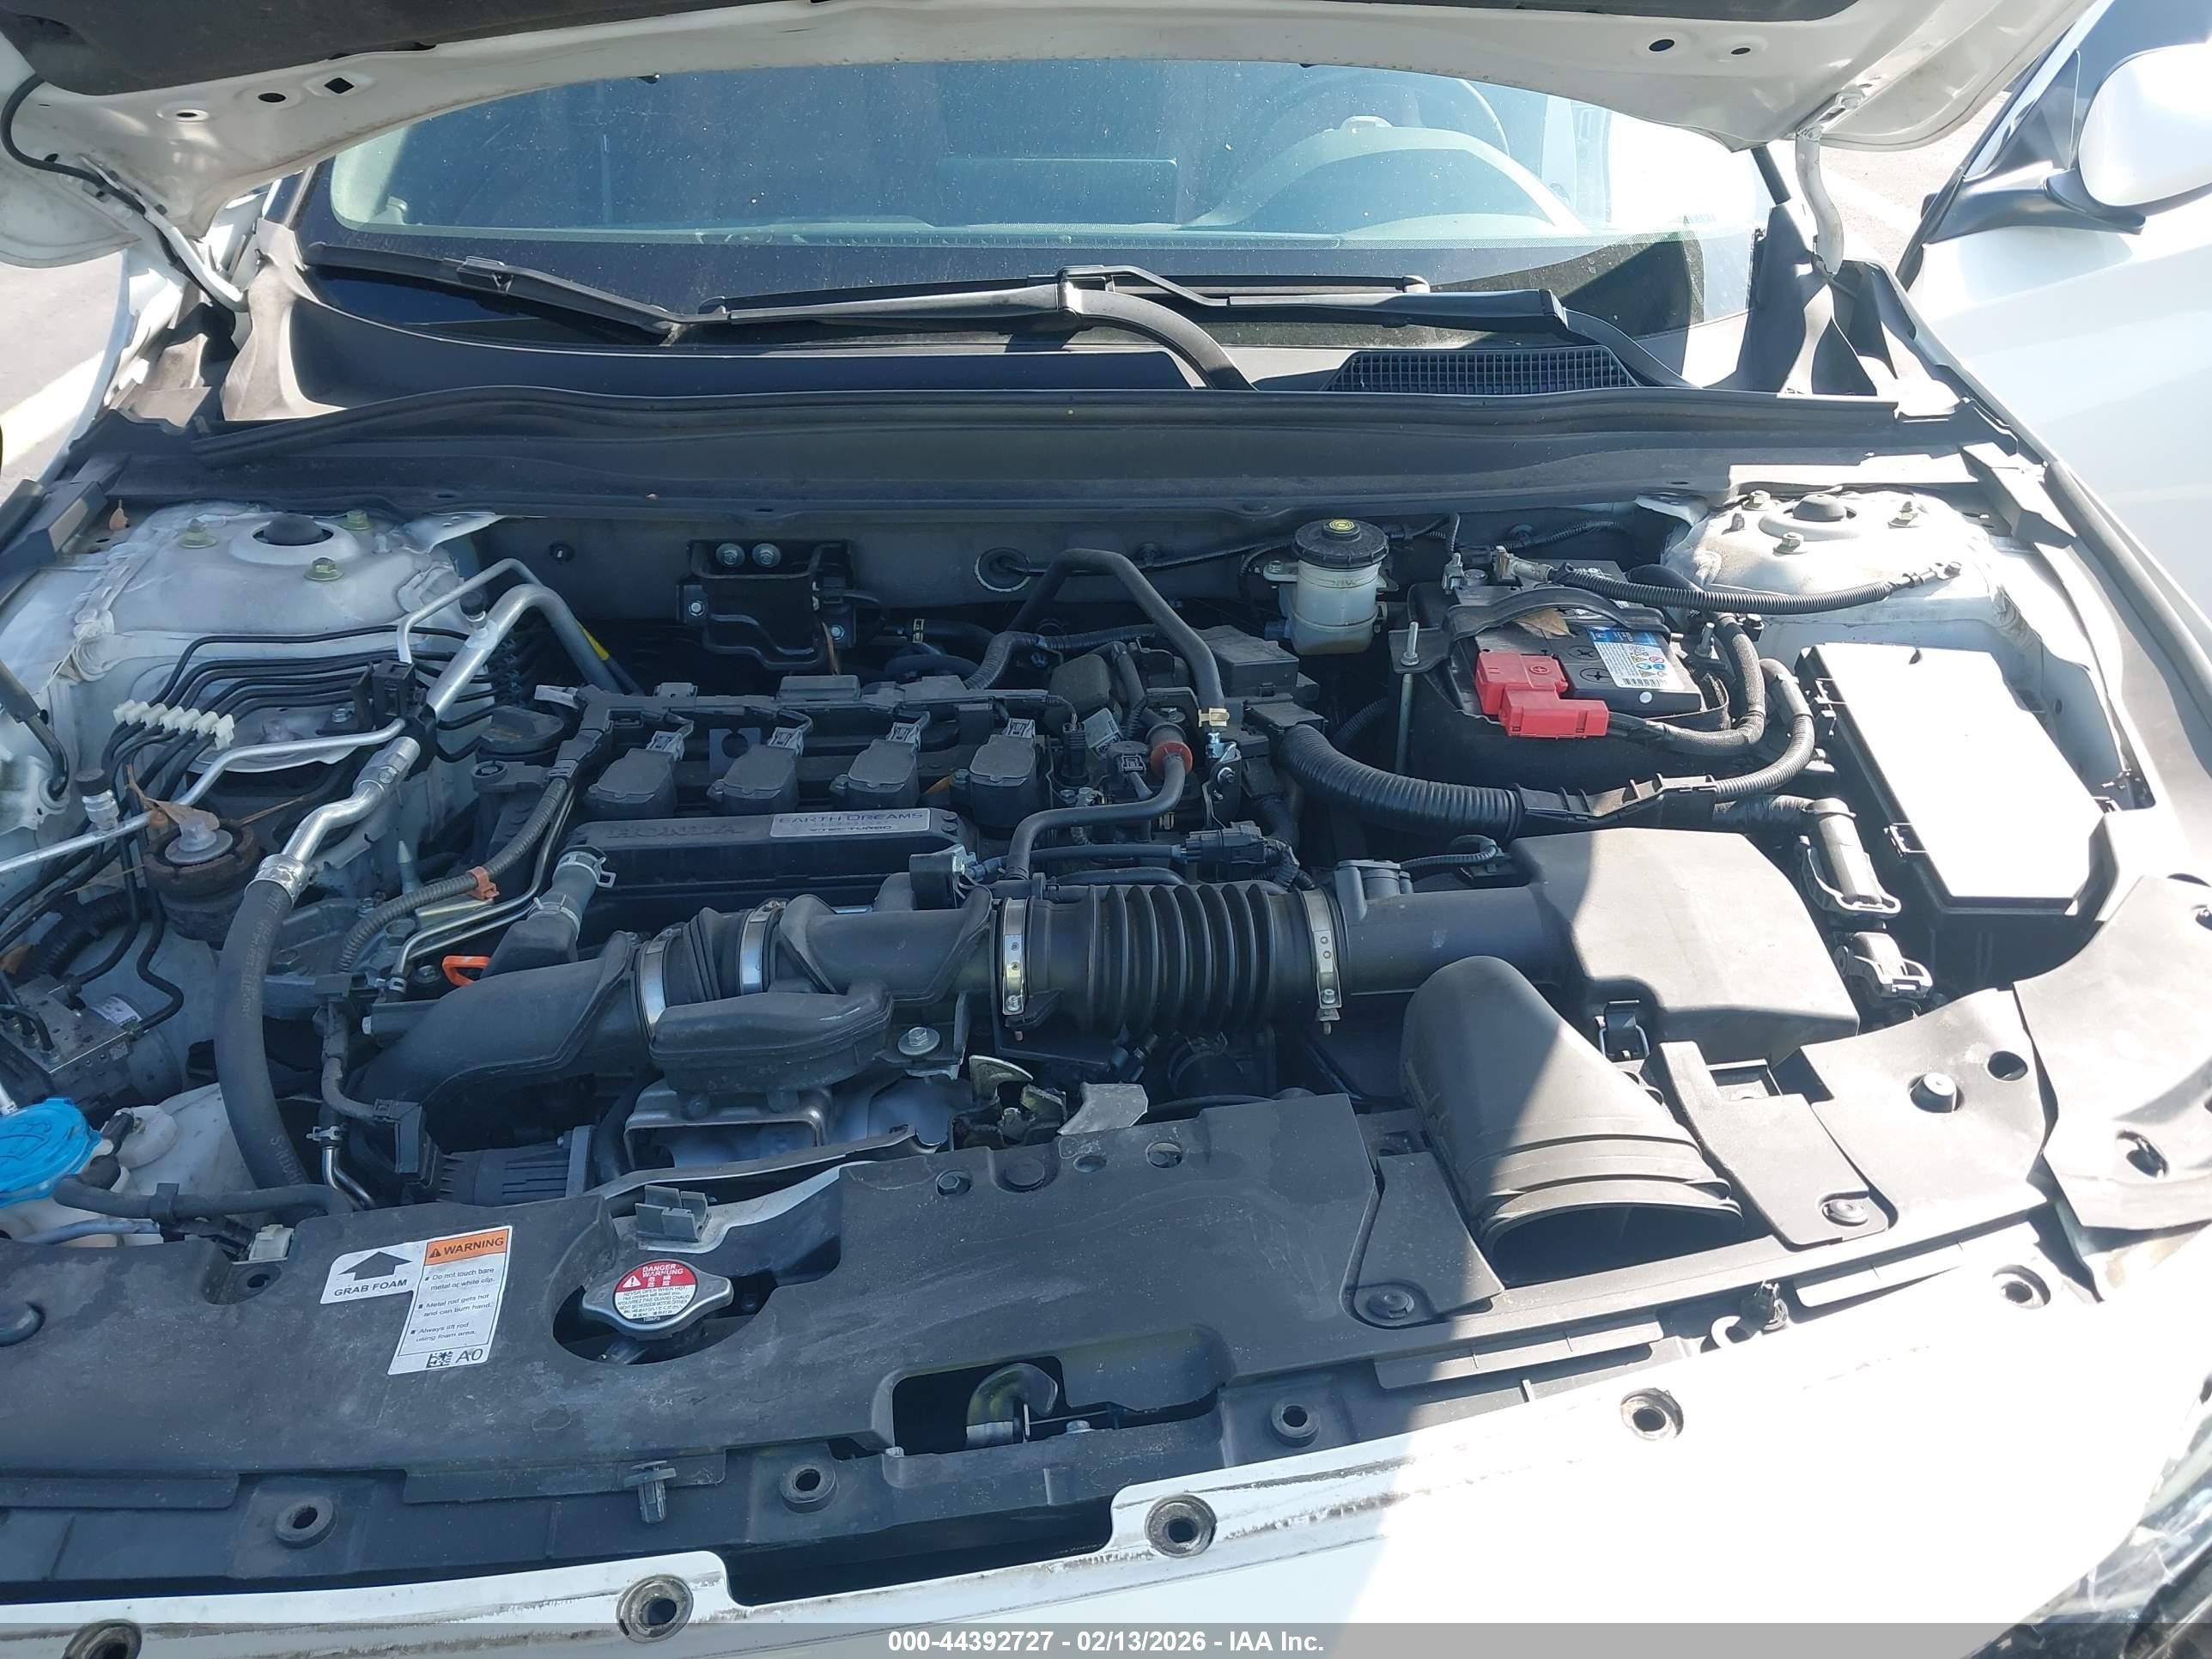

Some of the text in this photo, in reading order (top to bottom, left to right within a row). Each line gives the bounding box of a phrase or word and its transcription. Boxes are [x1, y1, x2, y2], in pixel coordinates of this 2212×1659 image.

[778, 811, 924, 824] EARTH DREAMS
[443, 1237, 505, 1256] WARNING
[457, 1269, 477, 1278] touch
[642, 1268, 684, 1278] WARNUNG
[334, 1279, 408, 1297] GRAB FOAM
[430, 1282, 451, 1291] metal
[461, 1279, 480, 1287] white
[426, 1300, 447, 1309] Metal
[460, 1296, 477, 1304] gets
[420, 1326, 445, 1334] Always
[416, 1334, 436, 1343] using
[455, 1348, 483, 1363] A0
